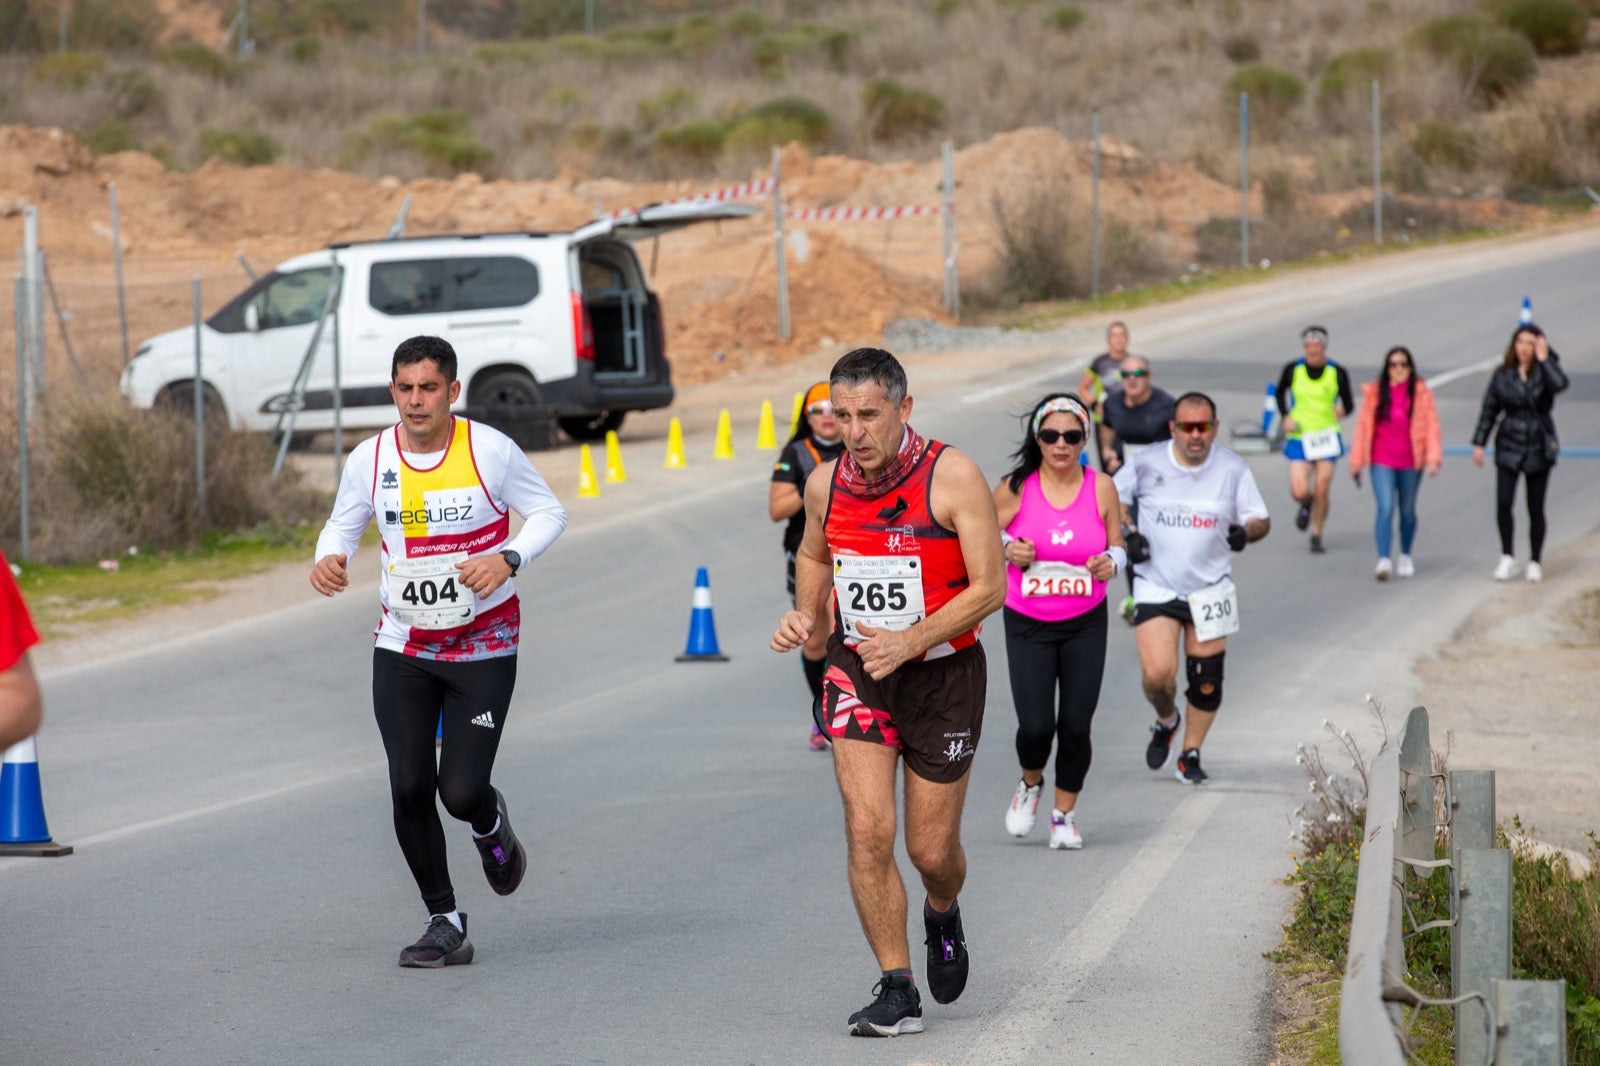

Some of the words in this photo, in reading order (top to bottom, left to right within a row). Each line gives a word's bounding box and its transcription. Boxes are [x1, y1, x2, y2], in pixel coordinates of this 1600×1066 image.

[1156, 511, 1219, 529] Autober
[410, 543, 458, 554] GRANADA
[458, 531, 497, 550] RUNNERS
[402, 577, 459, 606] 404
[847, 582, 907, 611] 265
[1028, 578, 1087, 595] 2160
[1202, 599, 1231, 621] 230
[471, 718, 495, 729] adidas
